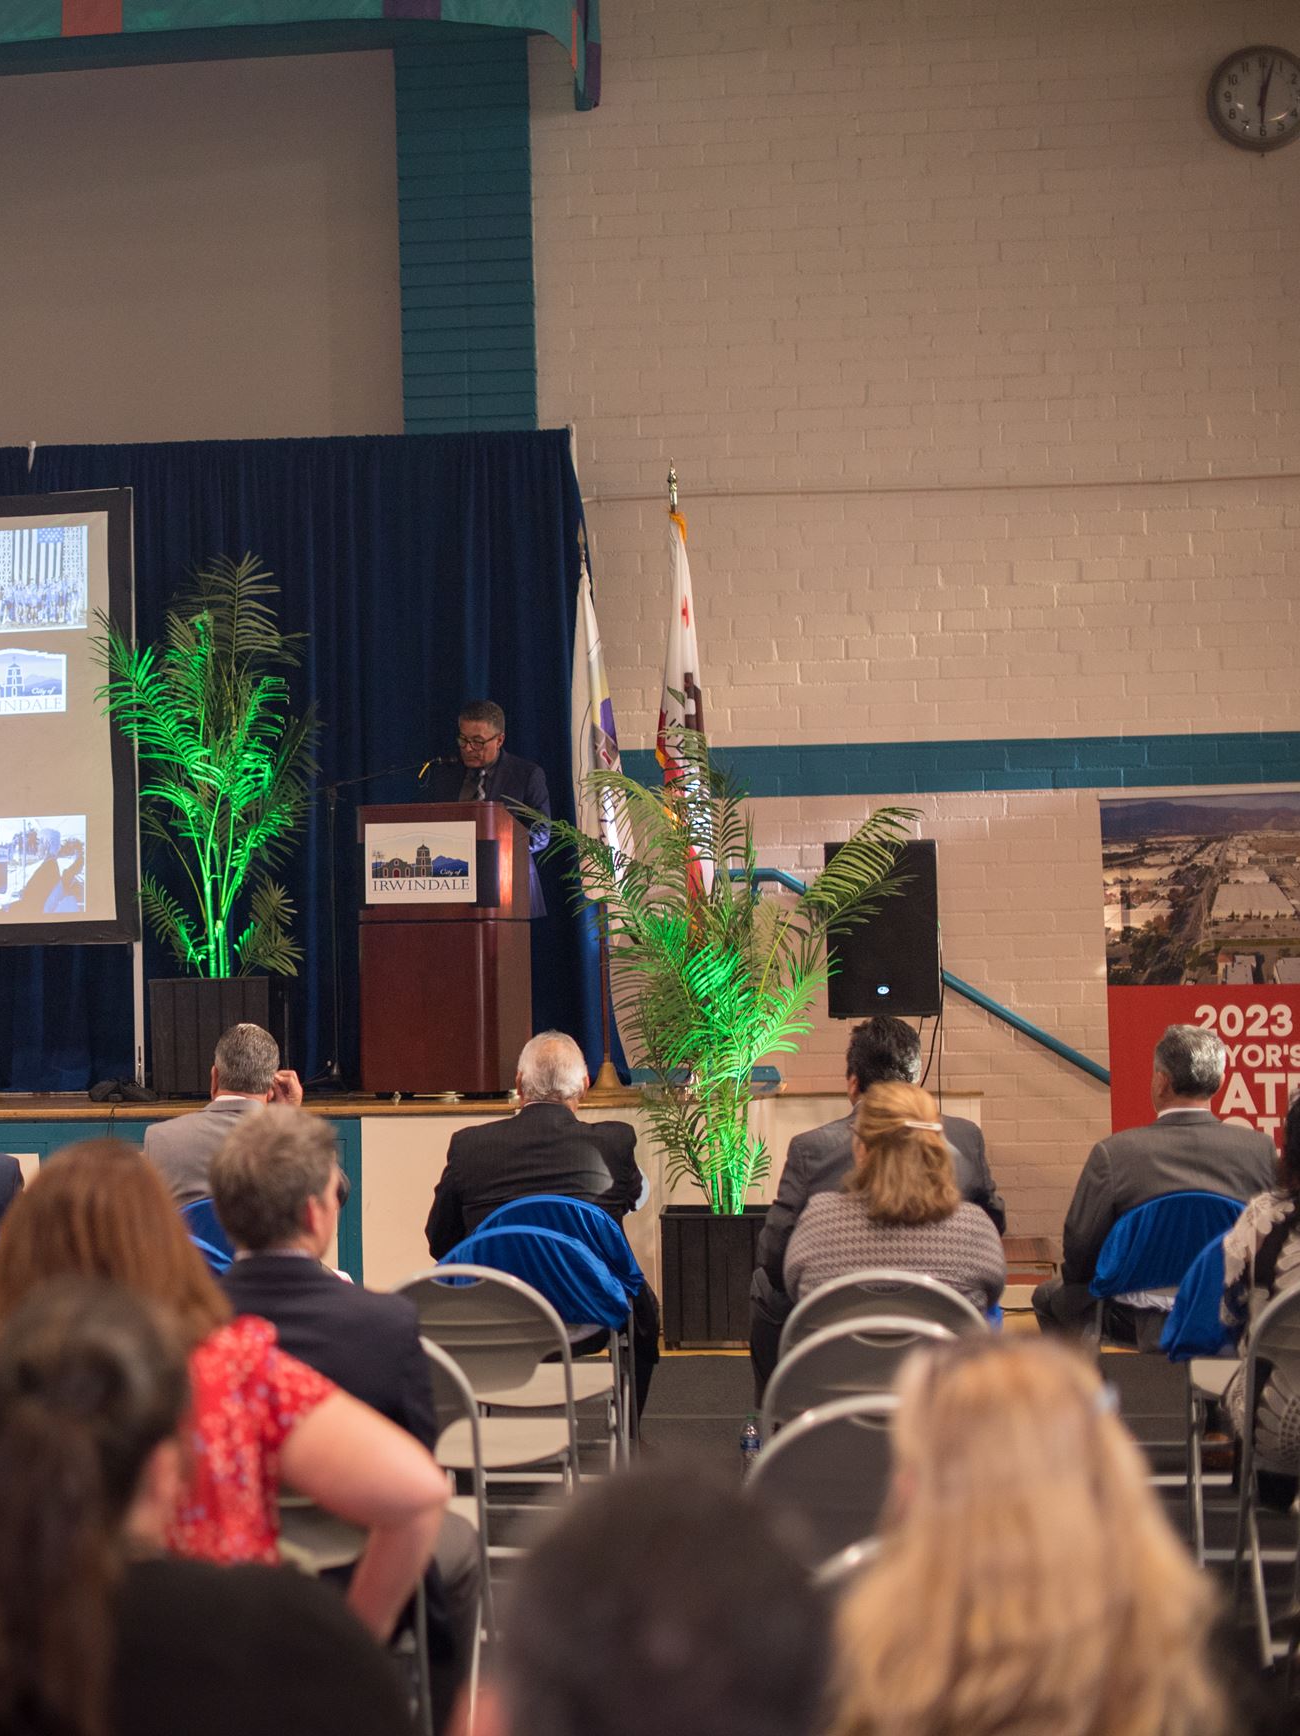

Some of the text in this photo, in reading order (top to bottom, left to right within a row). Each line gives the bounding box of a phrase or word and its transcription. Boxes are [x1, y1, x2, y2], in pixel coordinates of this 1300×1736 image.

[373, 879, 470, 891] IRWINDALE
[1194, 1004, 1294, 1037] 2023
[1224, 1044, 1300, 1067] YOR'S
